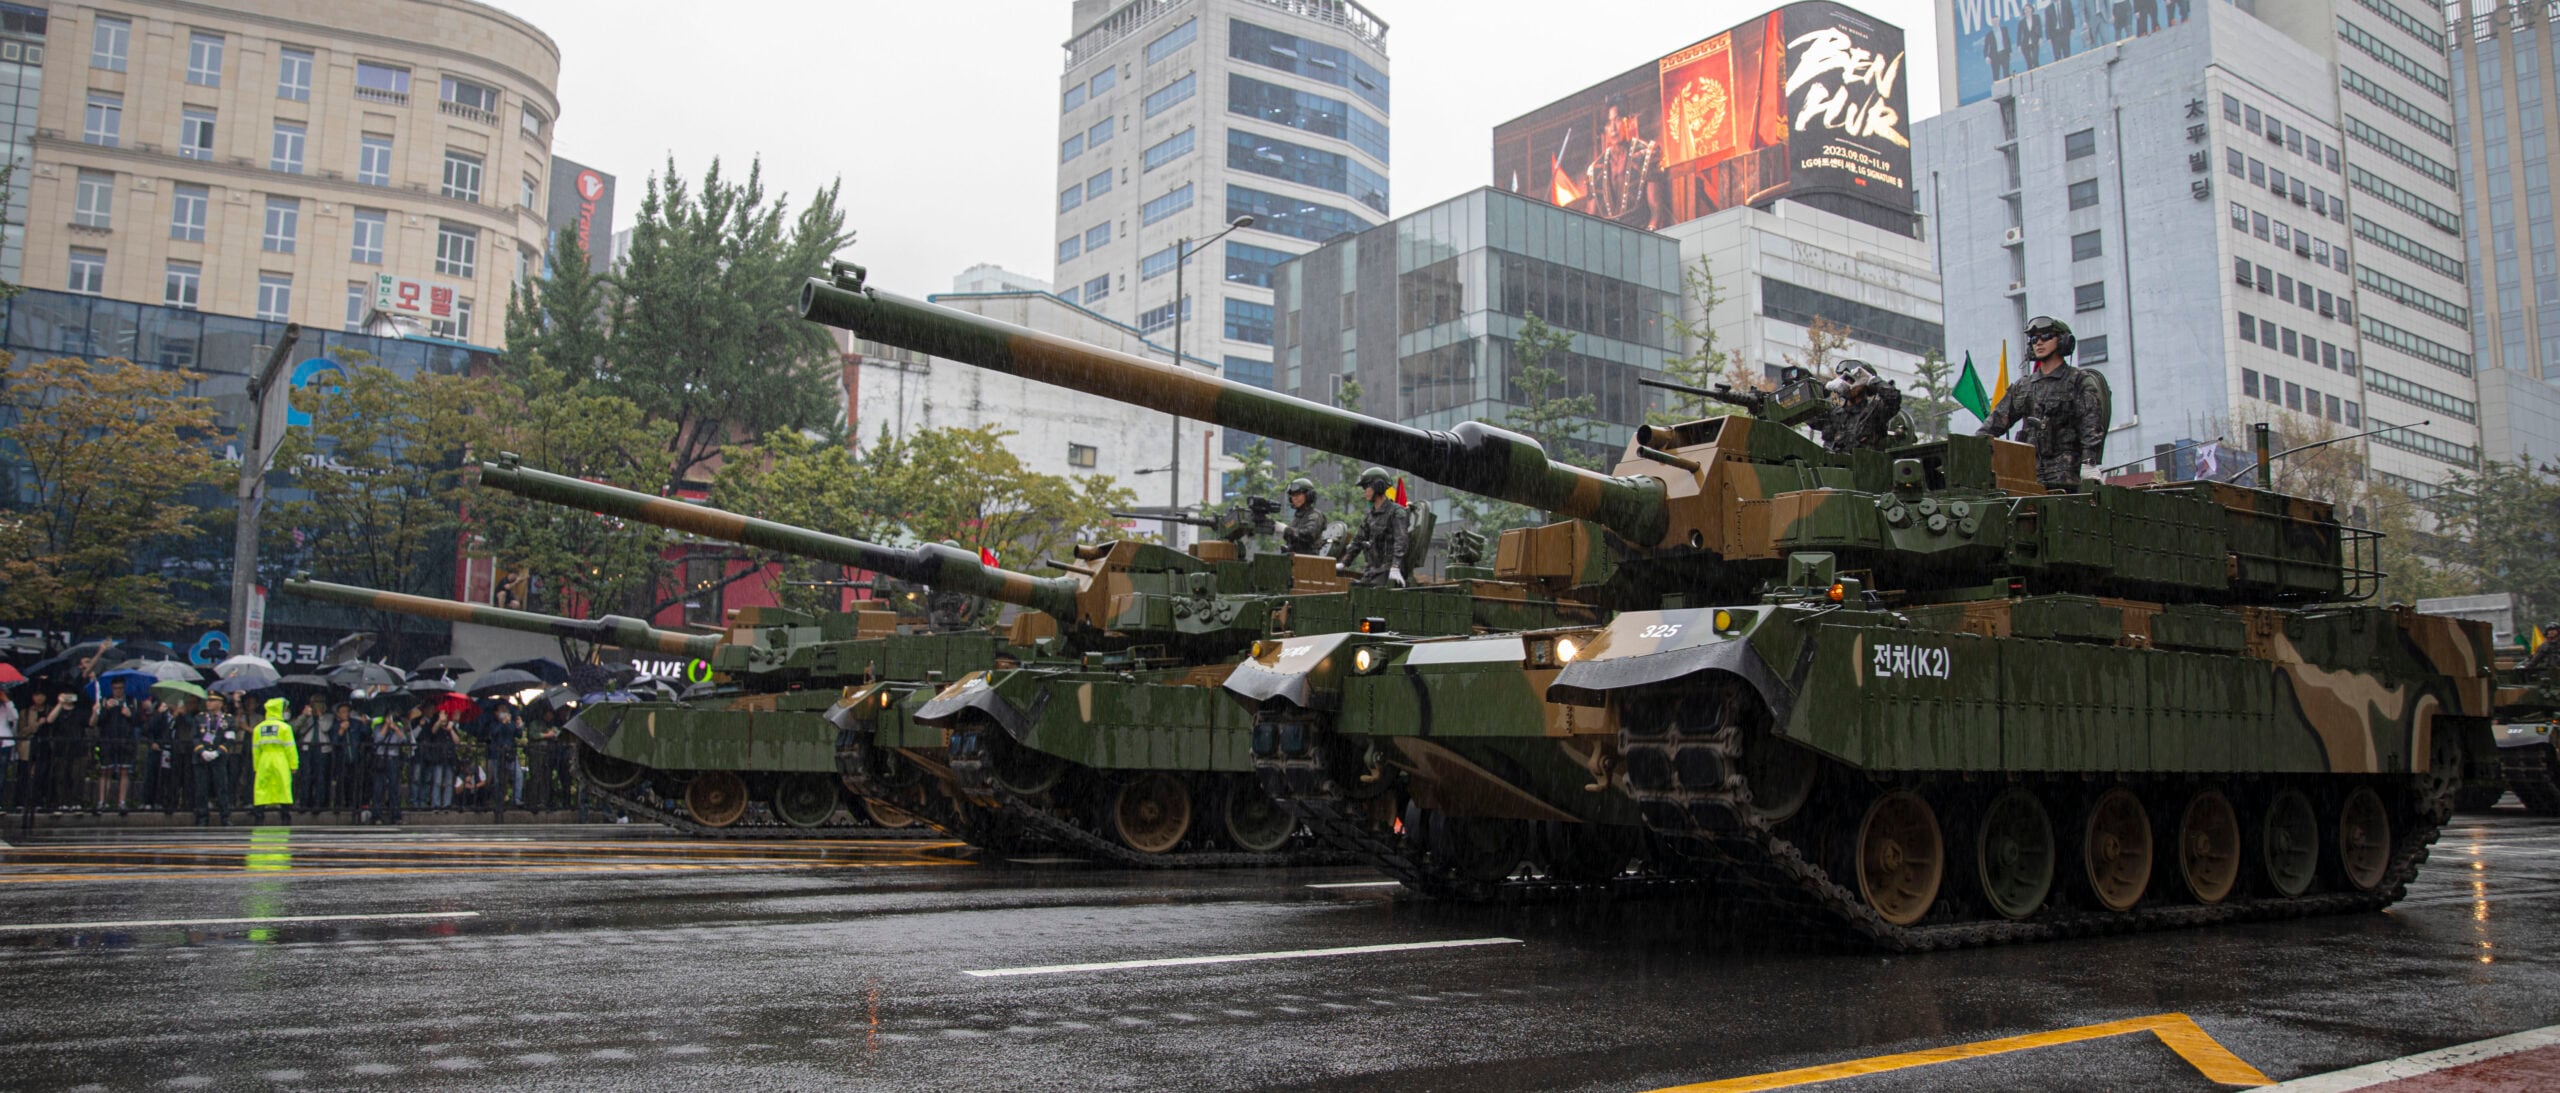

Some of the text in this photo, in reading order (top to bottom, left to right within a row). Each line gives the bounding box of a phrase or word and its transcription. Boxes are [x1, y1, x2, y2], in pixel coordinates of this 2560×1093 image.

[1785, 27, 1905, 98] BEN
[1795, 82, 1910, 149] HUR
[395, 280, 453, 317] 모텔
[1639, 624, 1683, 638] 325
[1873, 643, 1950, 680] 전차(K2)
